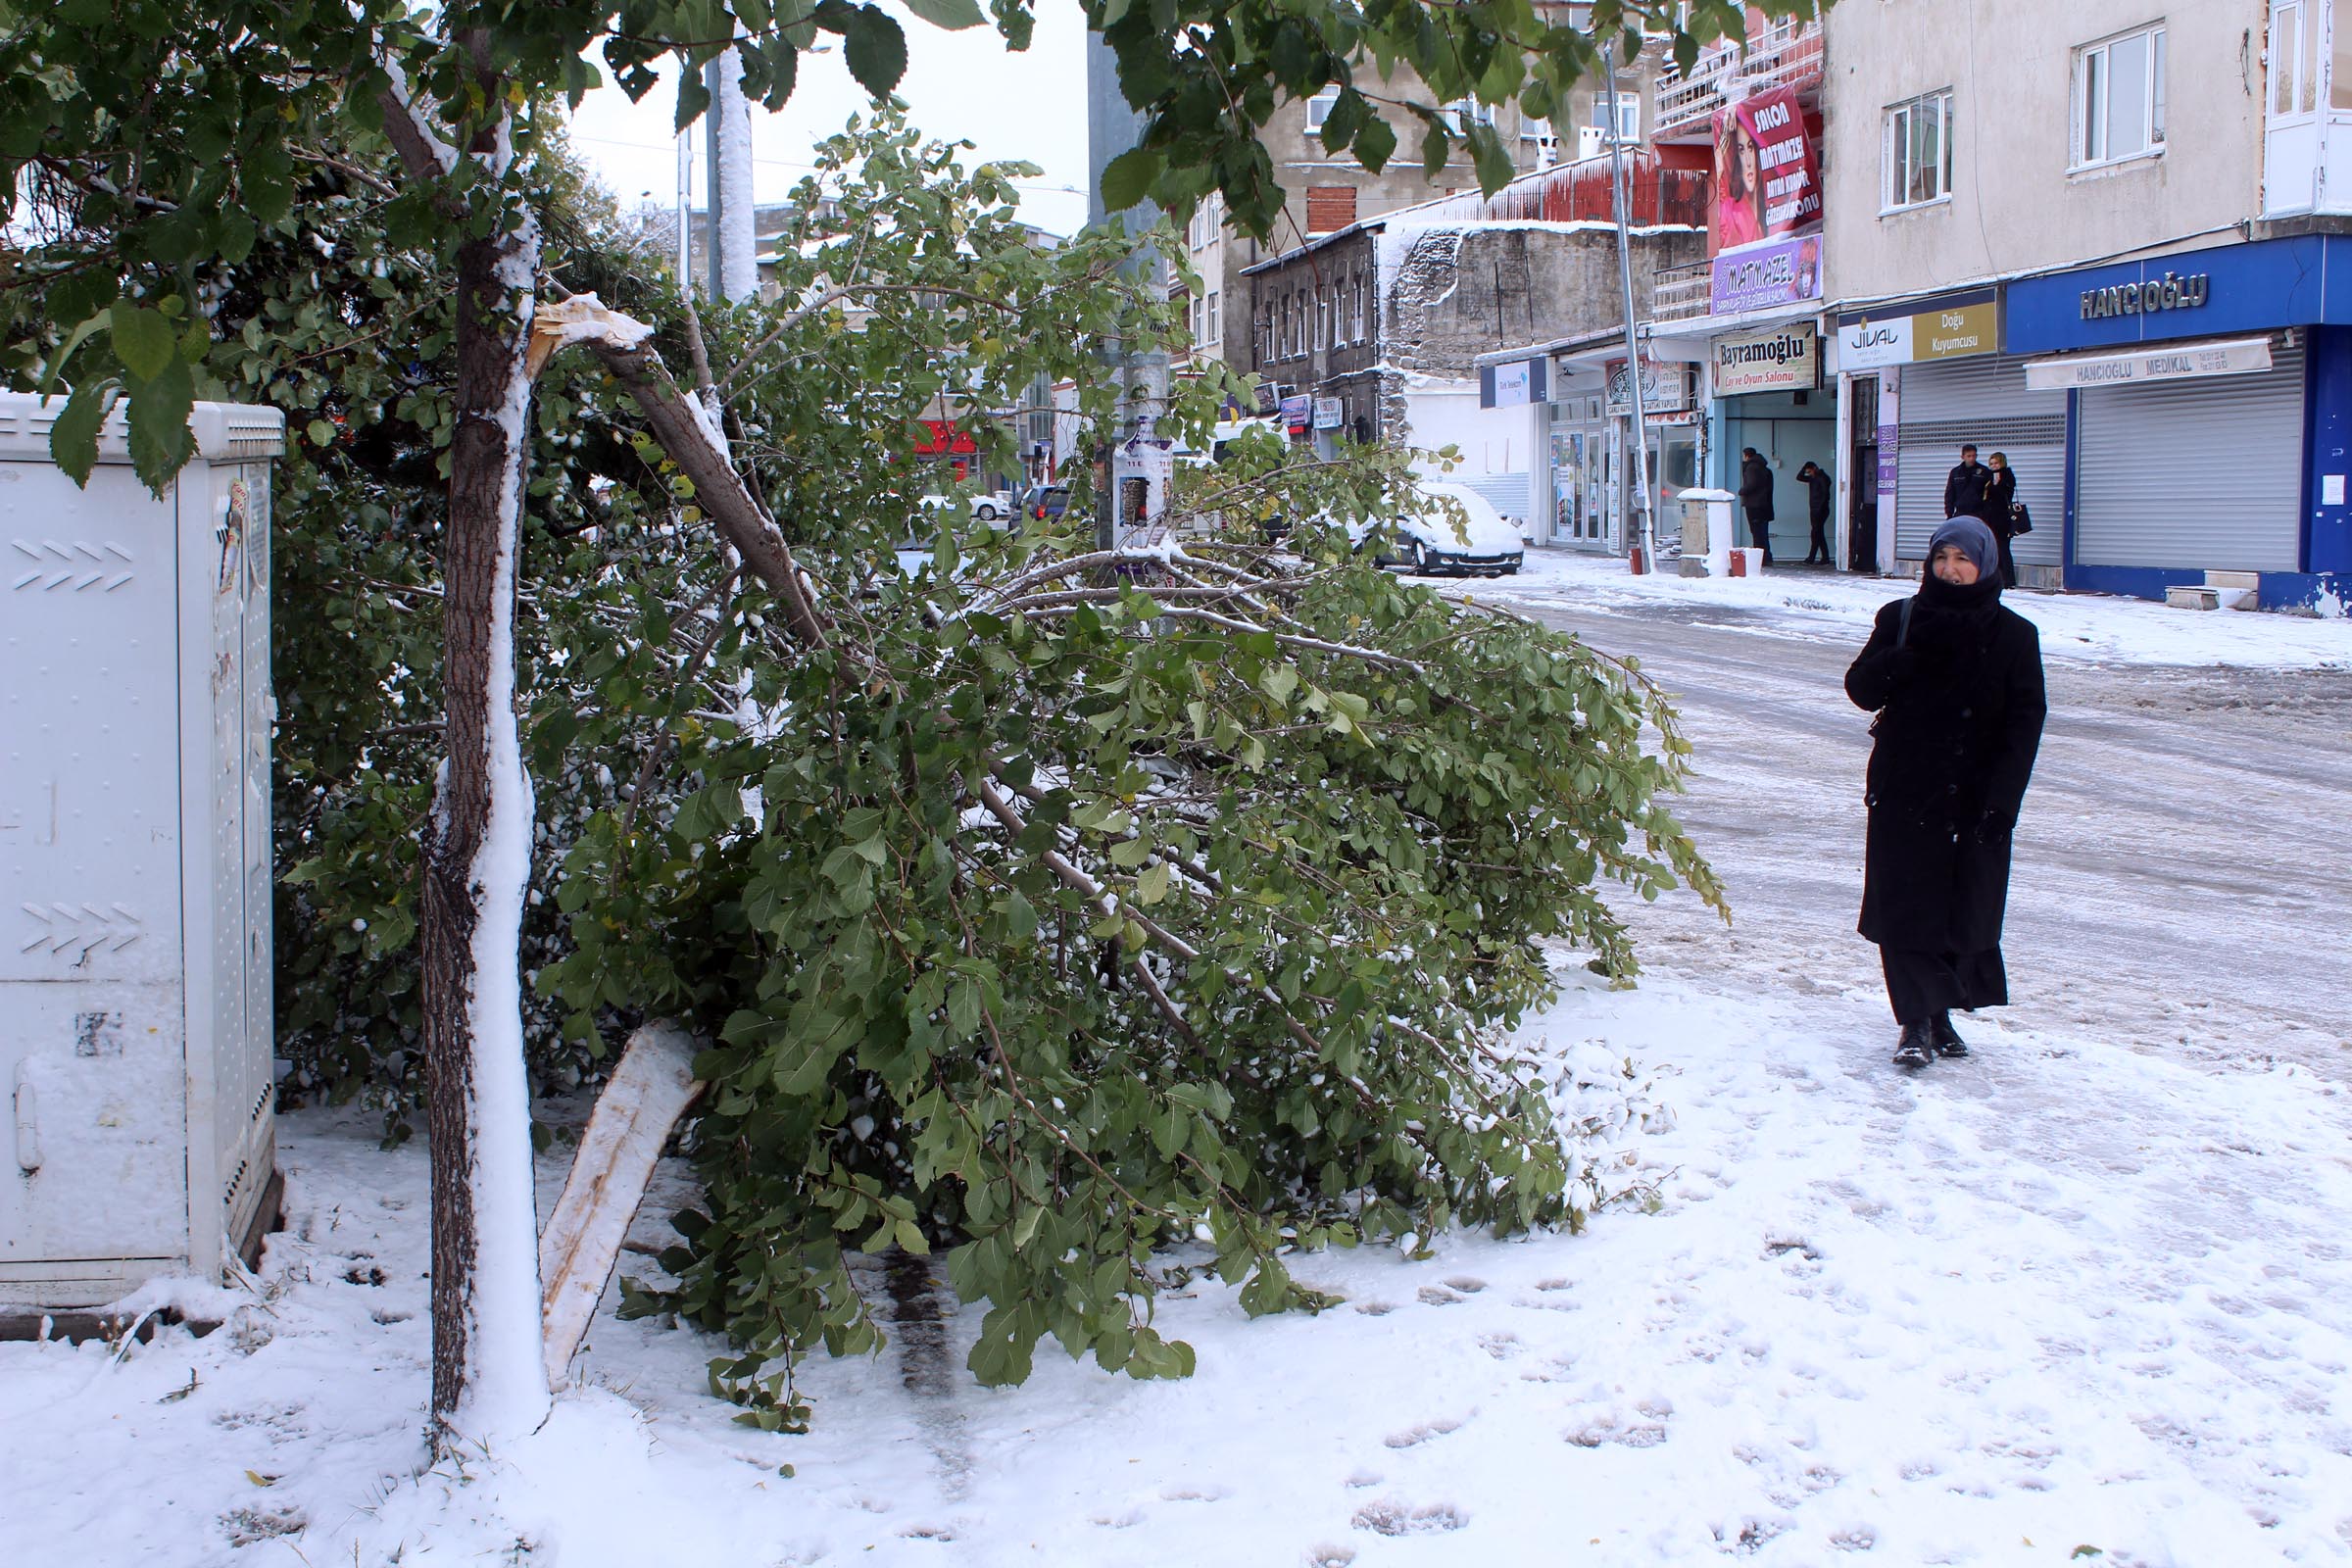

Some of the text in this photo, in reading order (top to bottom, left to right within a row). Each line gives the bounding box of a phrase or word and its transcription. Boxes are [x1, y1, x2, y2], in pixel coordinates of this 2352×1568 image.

[1754, 102, 1789, 134] SALON
[1726, 252, 1794, 296] MATMAZEL
[2080, 271, 2208, 319] HANCIOĞLU
[1941, 312, 1964, 330] Doğu
[1720, 334, 1804, 368] Bayramoğlu
[1932, 334, 1978, 354] Kuyumcusu
[1744, 373, 1762, 387] Oyun
[1765, 370, 1794, 383] Salonu
[2146, 356, 2192, 375] MEDİKAL
